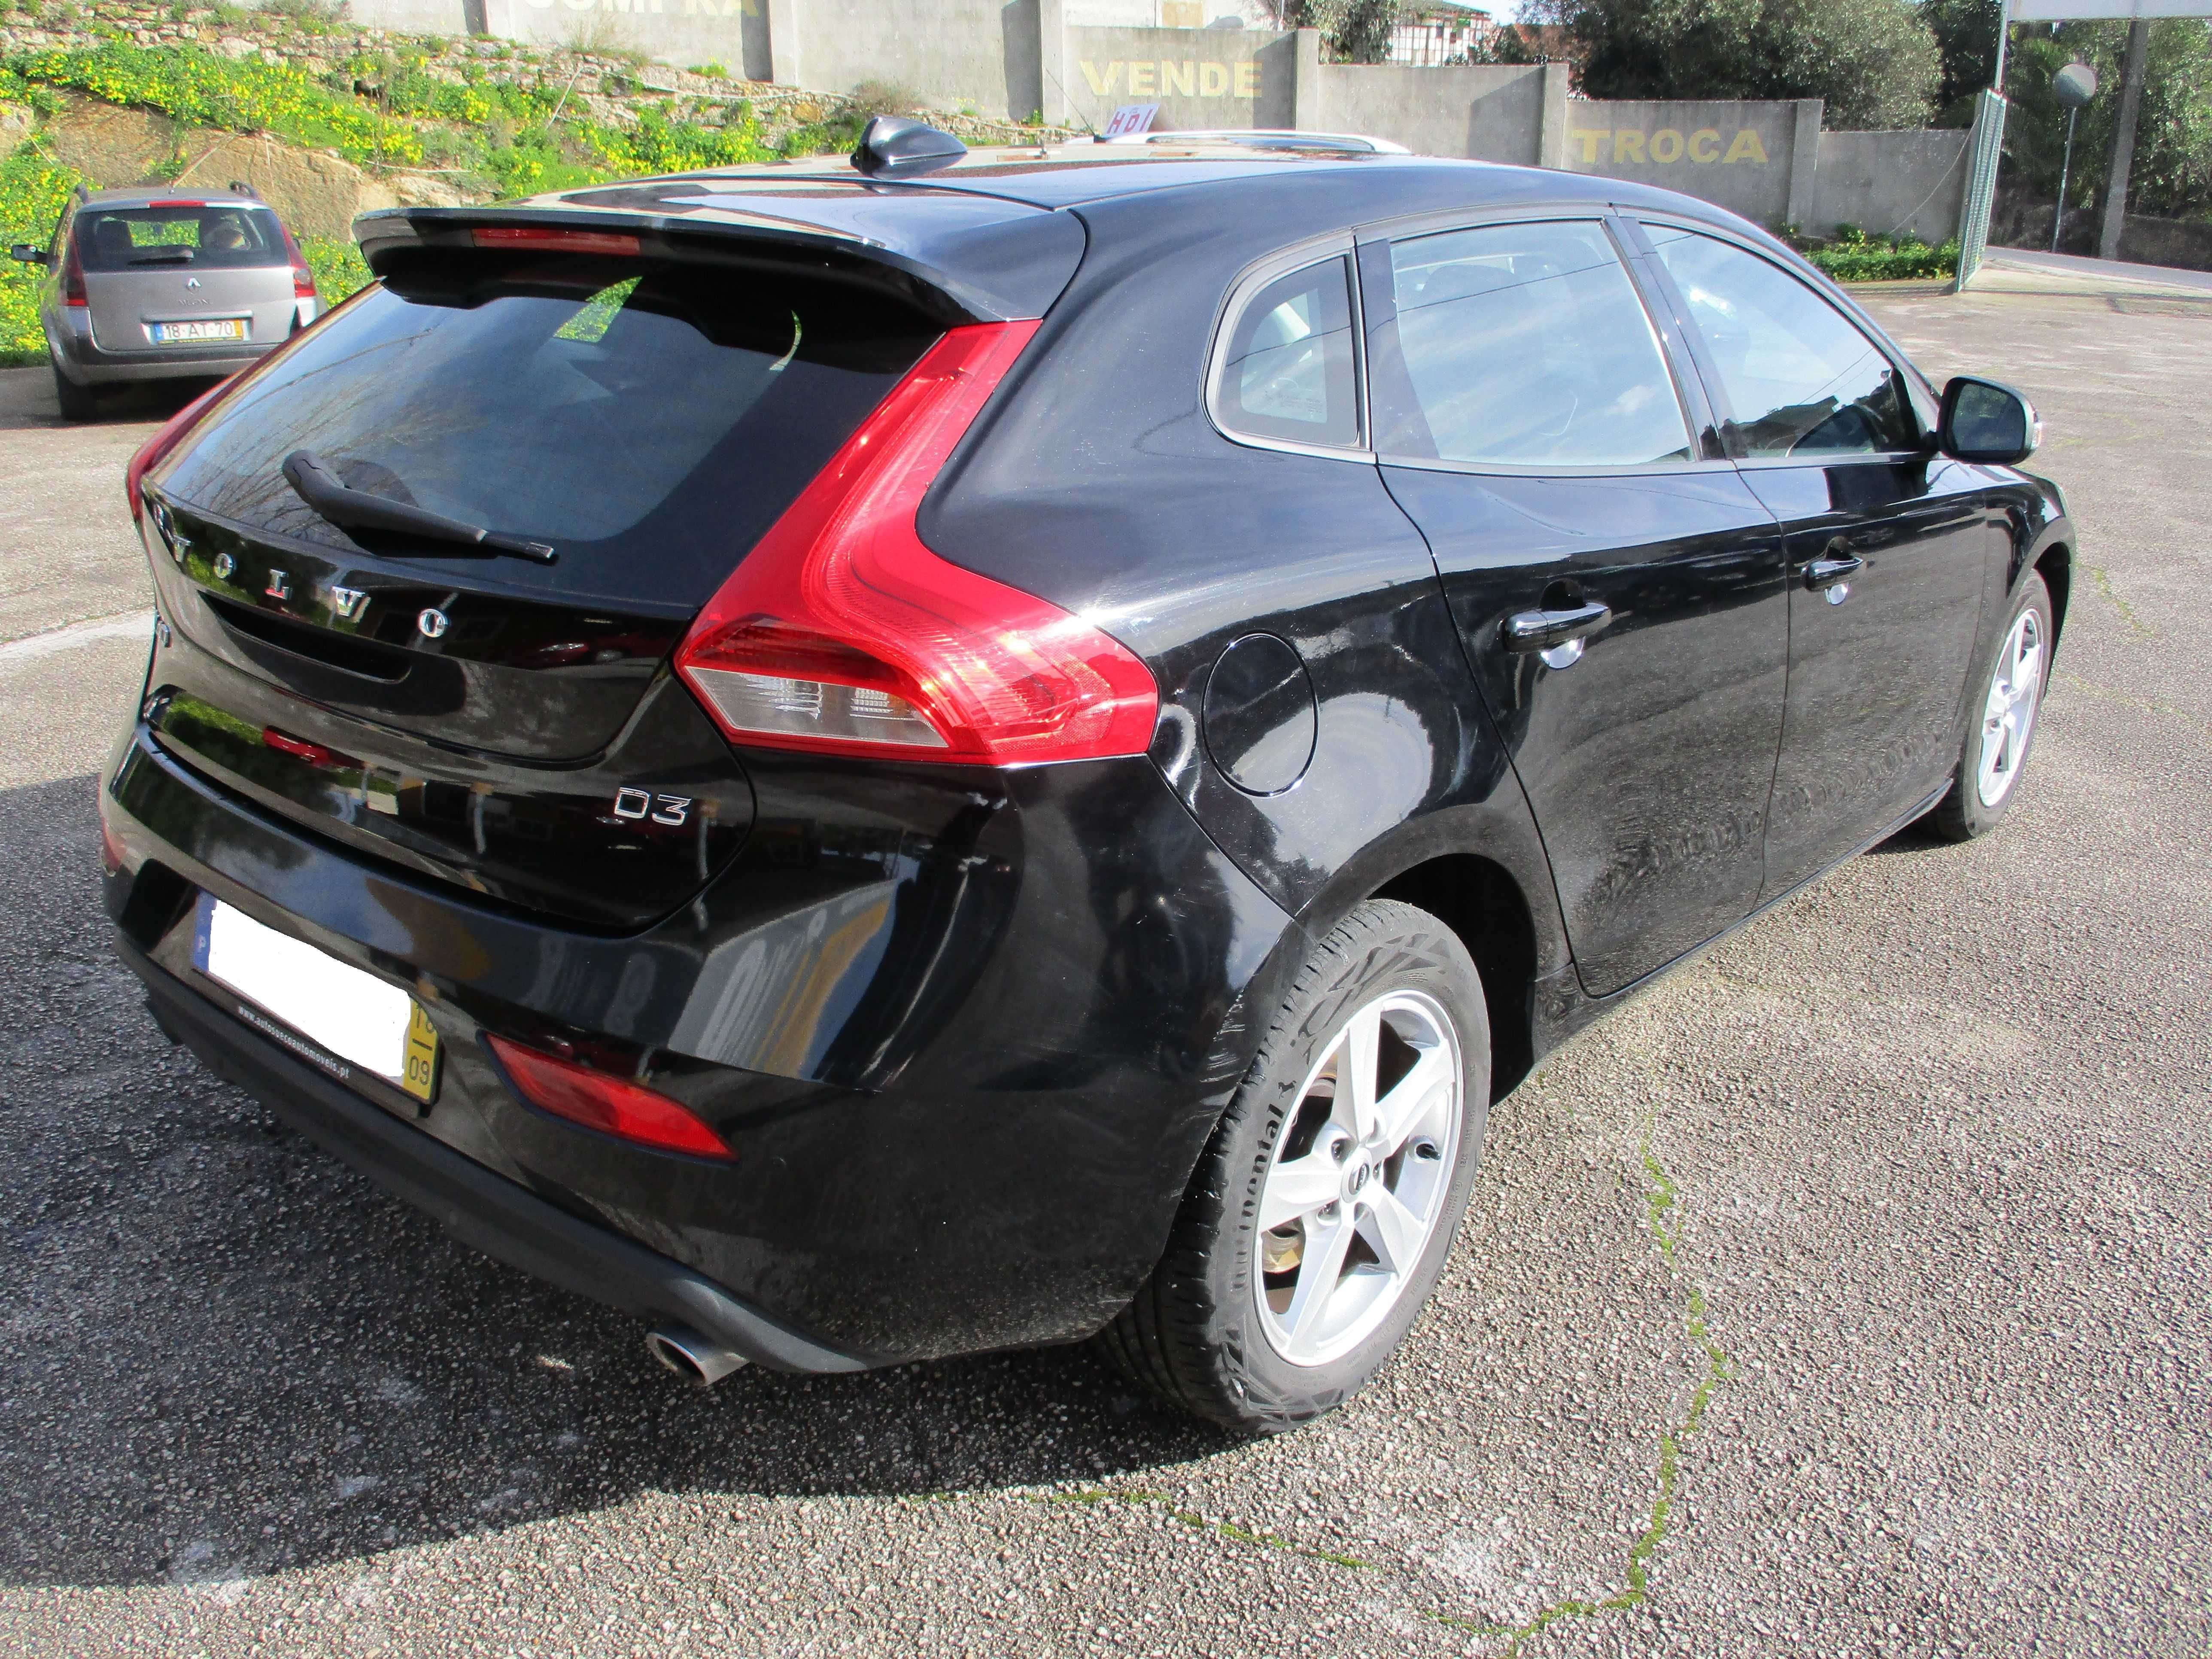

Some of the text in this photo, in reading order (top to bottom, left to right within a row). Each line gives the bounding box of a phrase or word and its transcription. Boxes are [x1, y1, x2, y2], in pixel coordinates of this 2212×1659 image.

[1079, 59, 1262, 98] VENDE
[1106, 108, 1154, 134] HDI
[1572, 128, 1769, 163] TROCA
[172, 535, 450, 638] VOLVO
[614, 787, 692, 826] D3
[409, 1054, 430, 1085] 09
